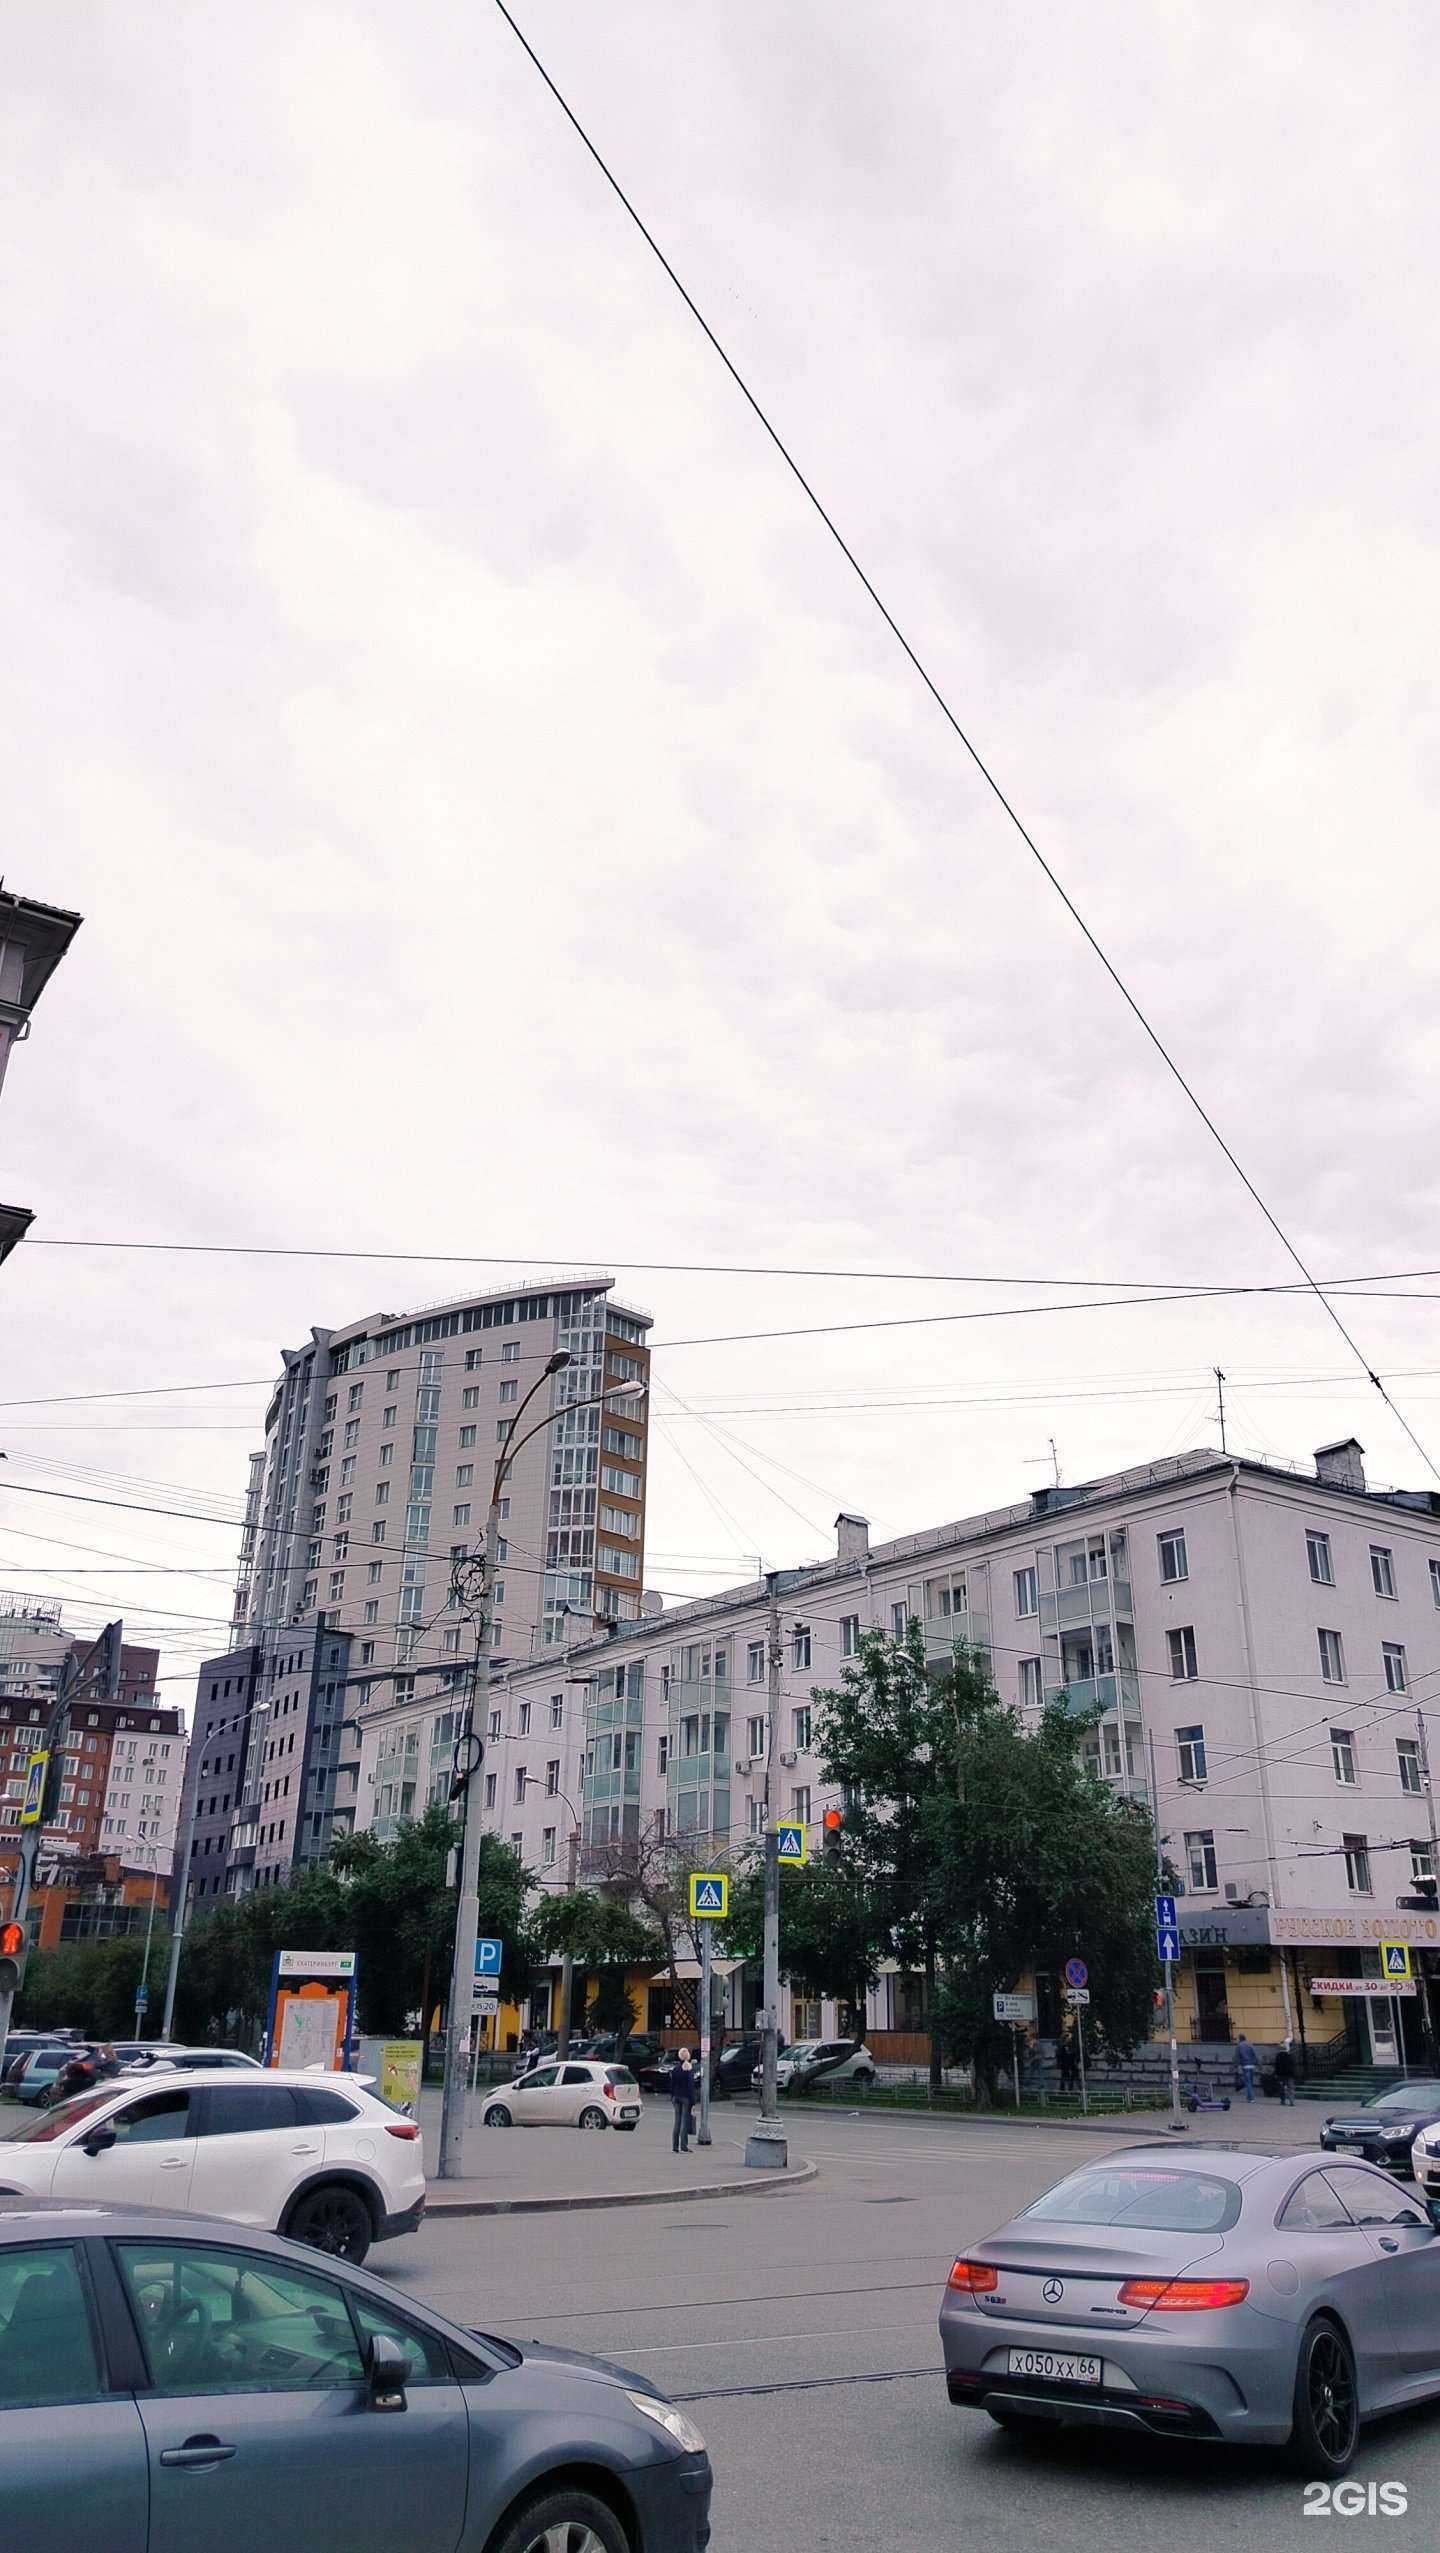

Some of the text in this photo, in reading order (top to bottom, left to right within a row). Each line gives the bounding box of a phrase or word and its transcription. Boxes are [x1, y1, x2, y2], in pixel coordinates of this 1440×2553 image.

[1274, 1917, 1437, 1939] РУССКОЕ ЗОЛОТО
[480, 1943, 496, 1970] P
[1311, 1981, 1353, 1992] СКИДКИ
[1364, 1982, 1378, 1991] 30
[1079, 2358, 1095, 2375] 66
